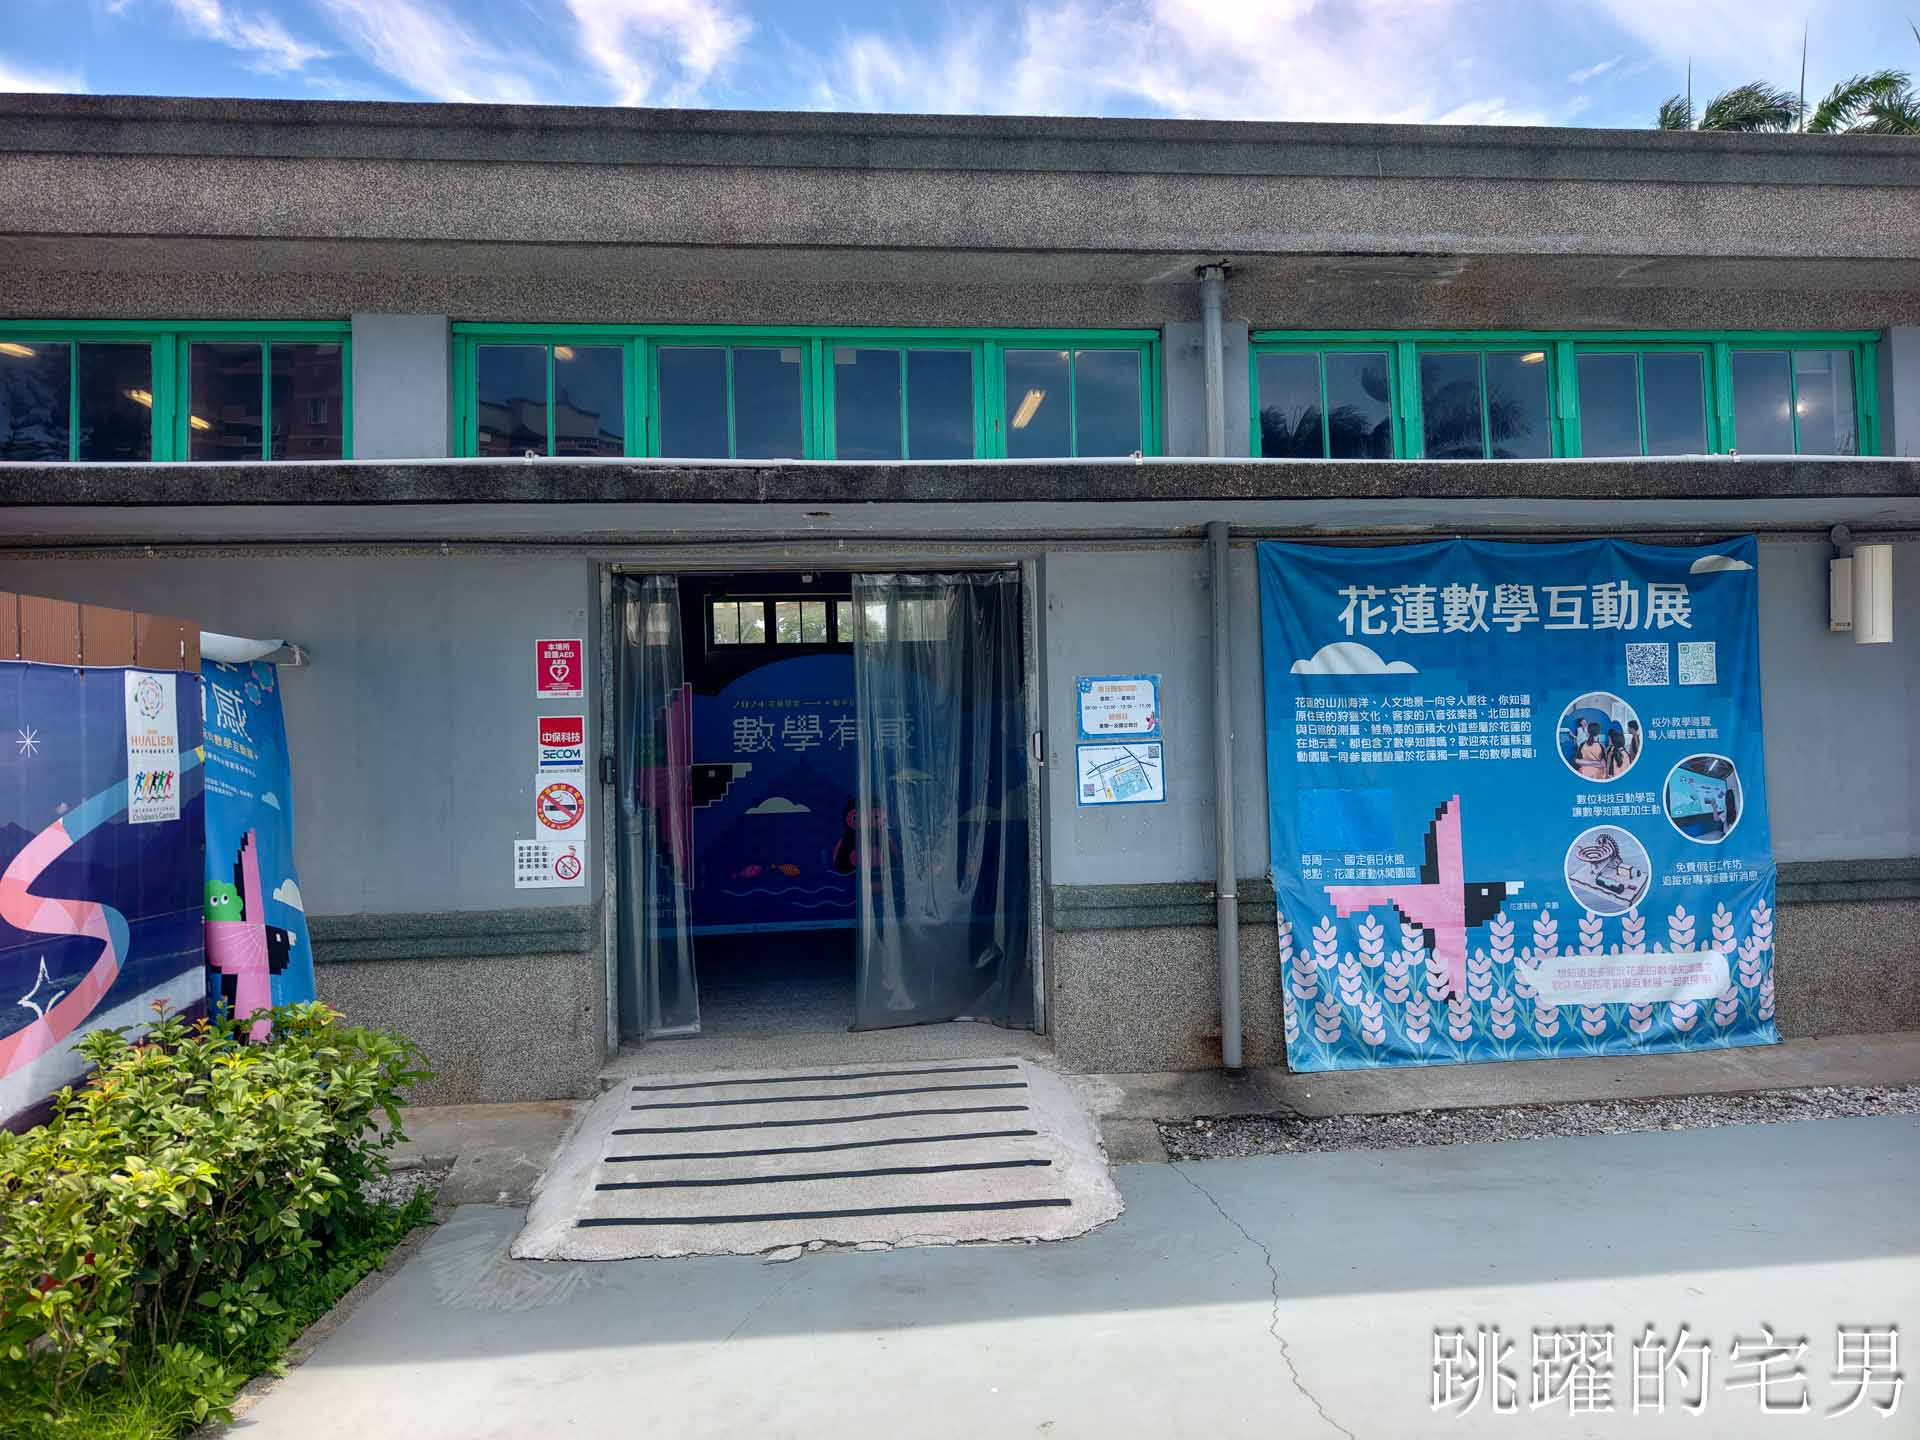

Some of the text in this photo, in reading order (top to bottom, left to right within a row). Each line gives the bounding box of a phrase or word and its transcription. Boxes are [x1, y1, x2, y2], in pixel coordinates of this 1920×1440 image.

[1338, 580, 1693, 635] 花蓮數學互動展
[130, 735, 174, 747] HUALIEN
[542, 732, 581, 744] 中保科技
[543, 749, 581, 759] SECOM
[1576, 792, 1656, 805] 數位科技互動學習
[1572, 805, 1661, 817] 讓數學知識更加生動
[1302, 854, 1405, 866] 每周一、國定假日休館
[1676, 859, 1743, 873] 免費假日工作坊
